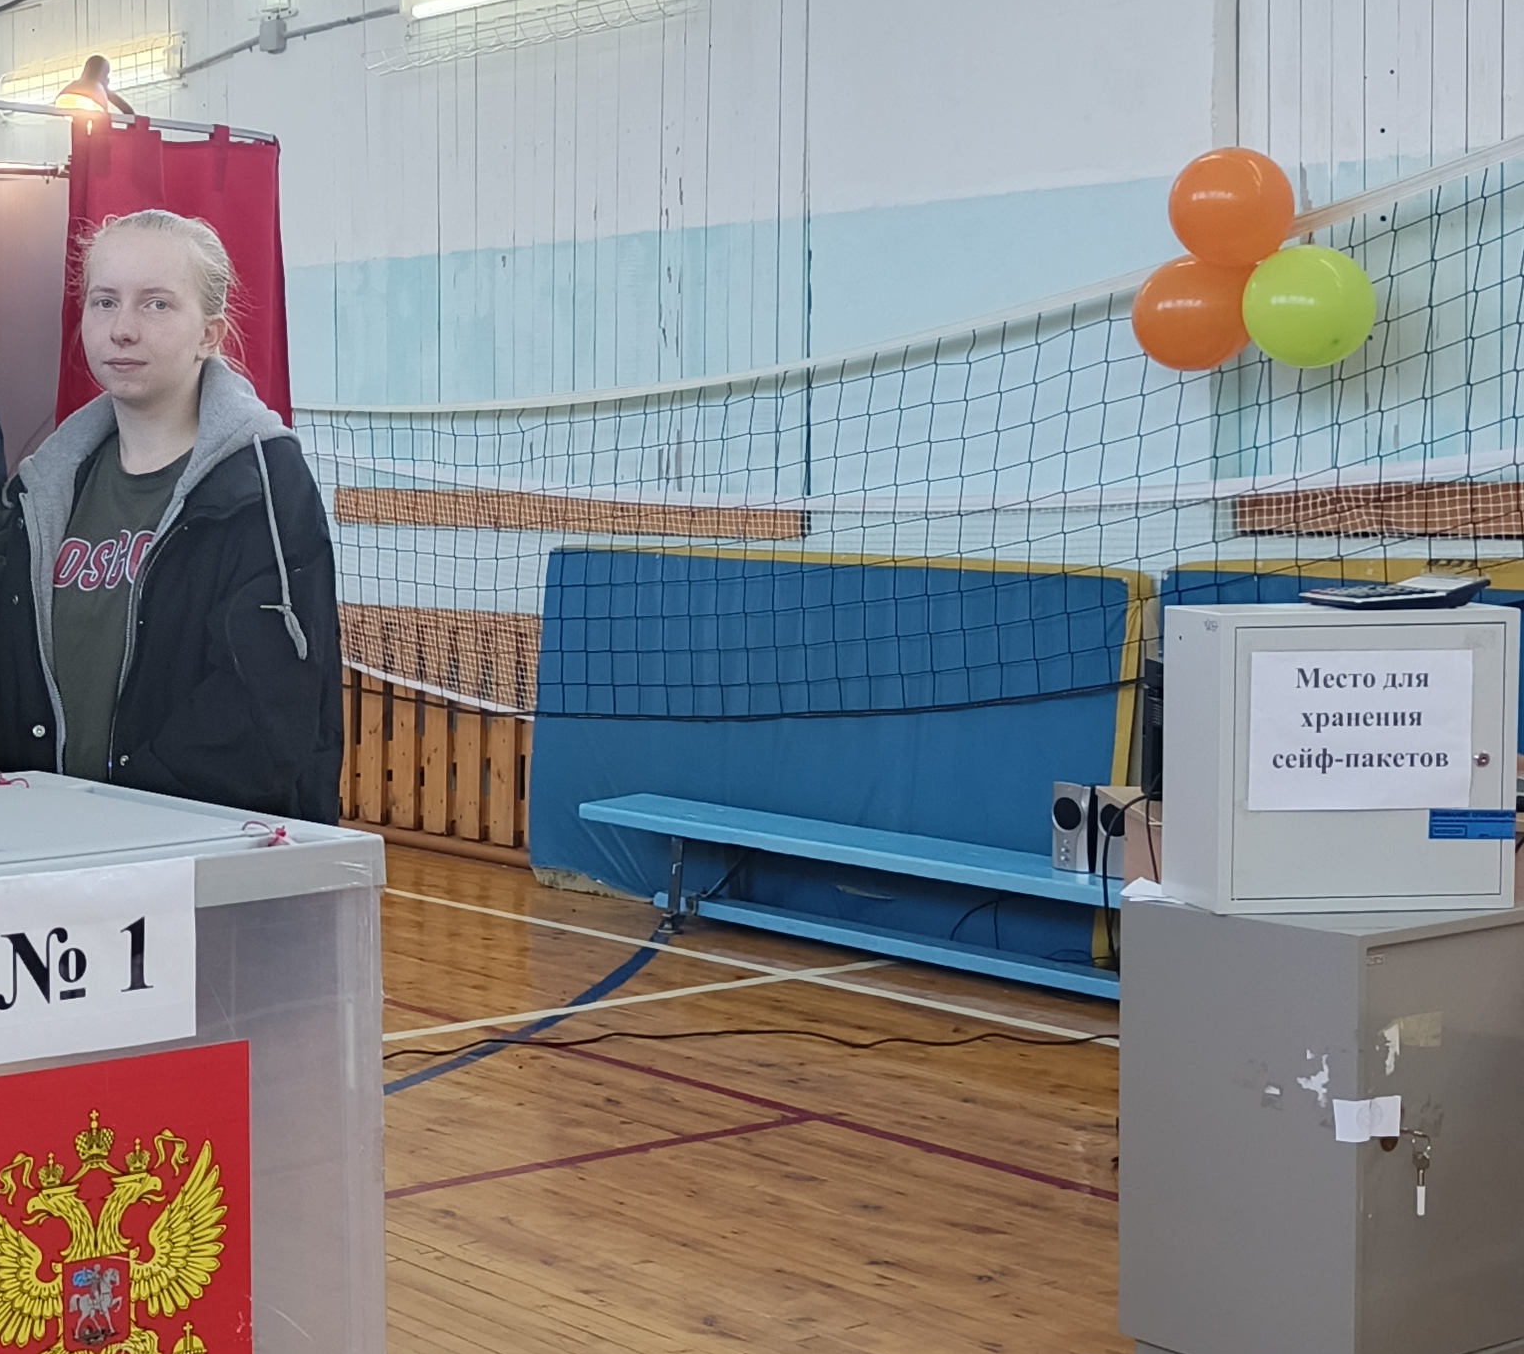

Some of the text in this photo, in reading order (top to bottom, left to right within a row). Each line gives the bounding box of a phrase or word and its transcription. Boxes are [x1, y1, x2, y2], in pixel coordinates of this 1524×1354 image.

[1296, 667, 1429, 690] Место для
[1301, 711, 1423, 733] хранения
[1272, 747, 1449, 774] сейф-пакетов
[120, 916, 154, 992] 1
